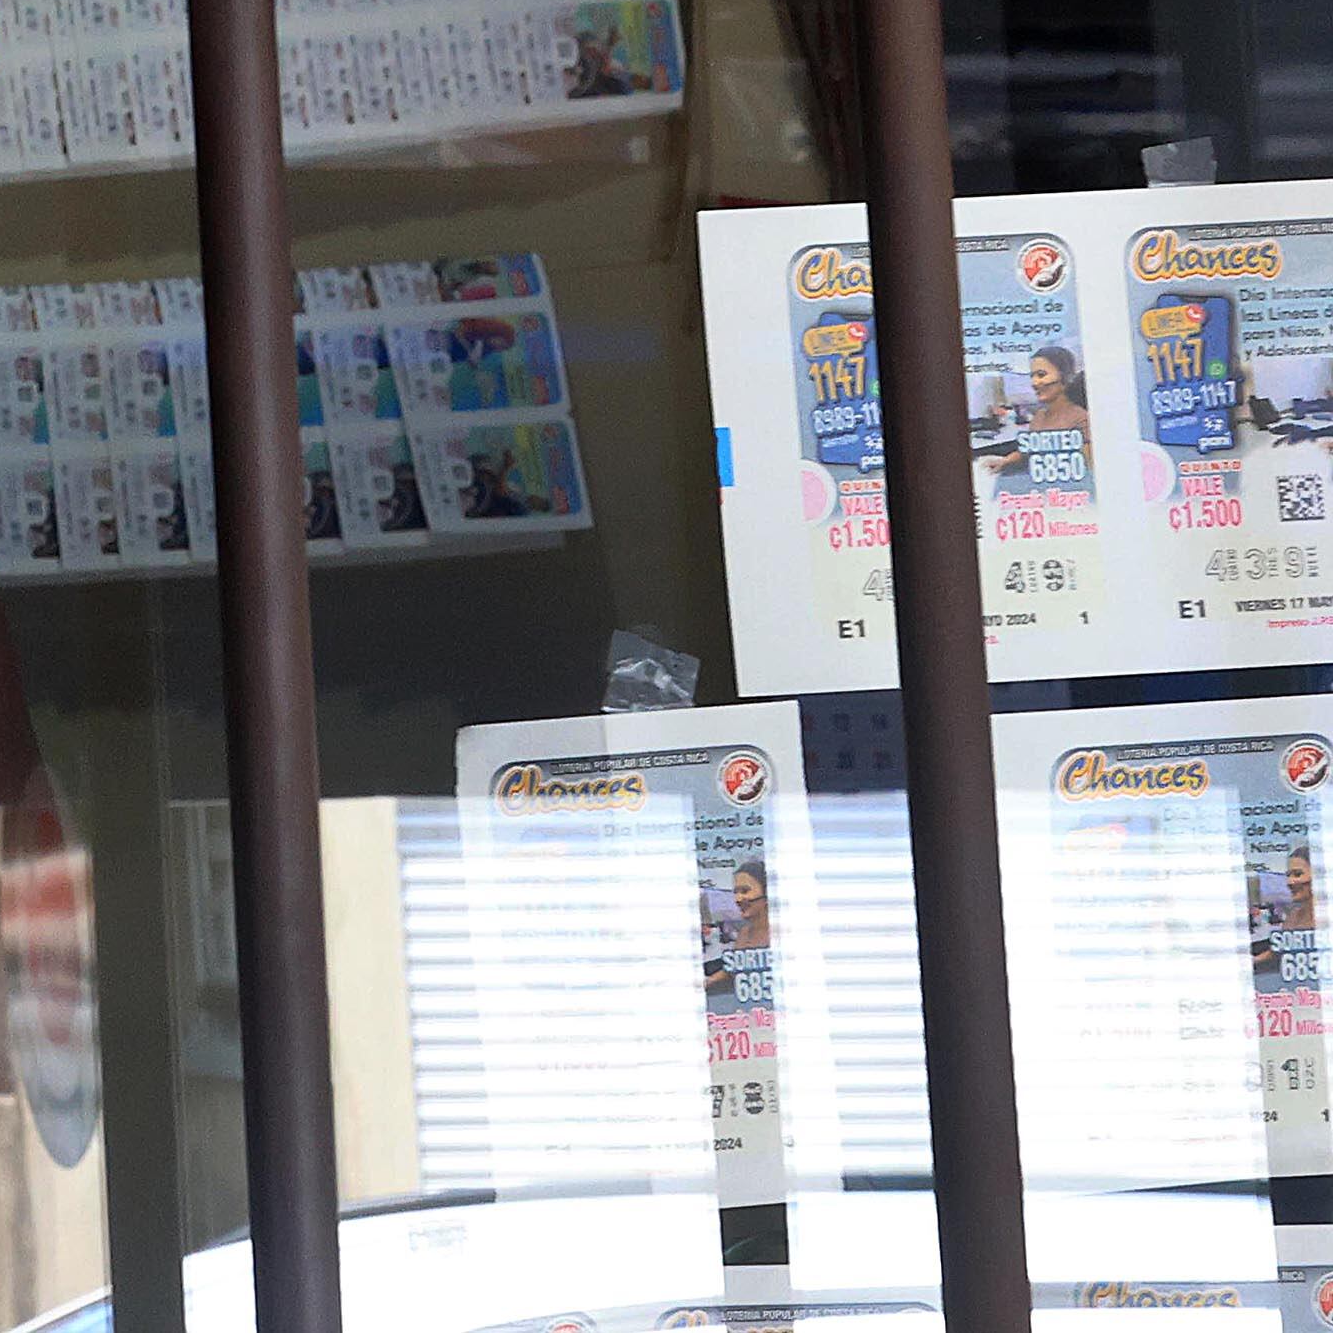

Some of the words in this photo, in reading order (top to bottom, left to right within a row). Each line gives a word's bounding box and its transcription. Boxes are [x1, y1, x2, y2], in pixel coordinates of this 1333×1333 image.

[1131, 231, 1284, 279] Chances
[1145, 337, 1206, 385] 1147
[807, 355, 868, 404] 1147
[1150, 379, 1238, 415] 8989-1147
[1017, 428, 1082, 454] SORTEO
[1028, 451, 1084, 484] 6850
[1045, 485, 1087, 511] Mayor
[1180, 476, 1225, 498] VALE
[1045, 519, 1097, 538] Millones
[1178, 597, 1206, 620] E1
[838, 617, 866, 639] E1
[1061, 752, 1208, 799] Chances
